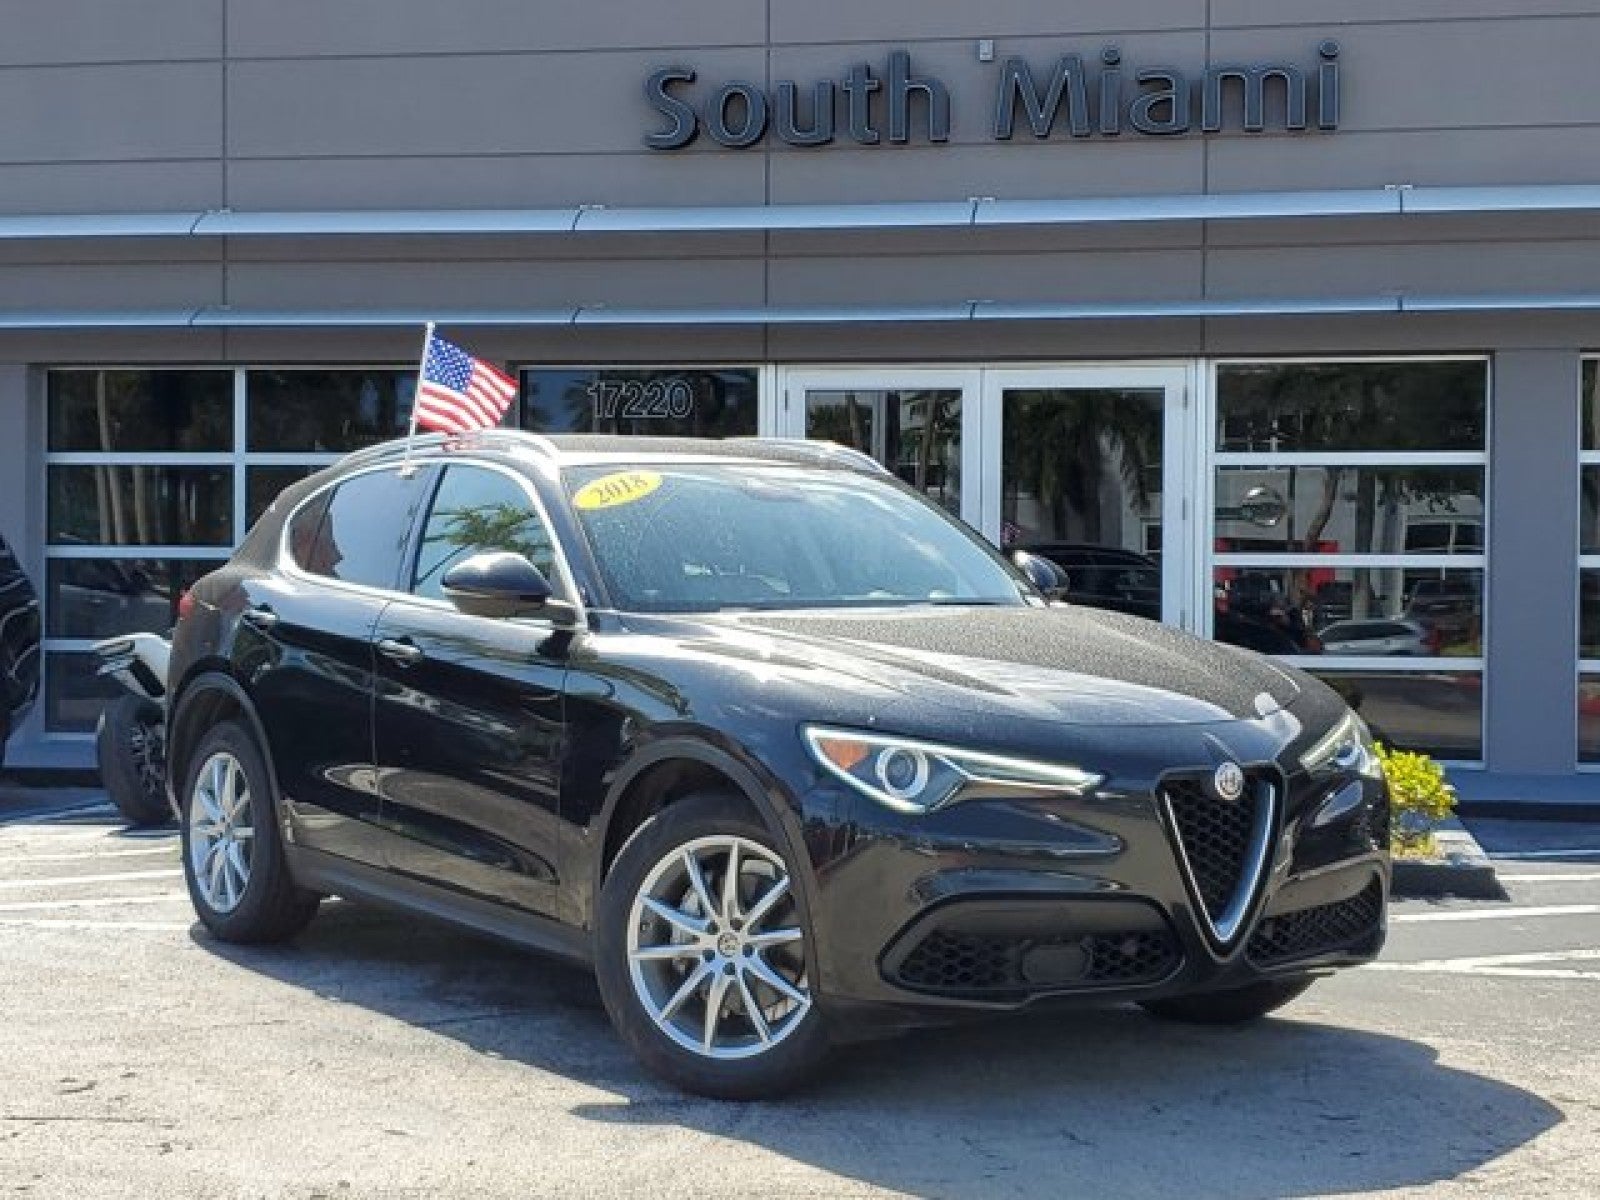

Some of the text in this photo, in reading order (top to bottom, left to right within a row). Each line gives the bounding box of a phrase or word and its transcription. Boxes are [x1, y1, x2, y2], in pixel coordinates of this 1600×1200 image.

[643, 41, 1342, 149] South Miami
[586, 379, 693, 418] 17220
[589, 474, 649, 503] 2018
